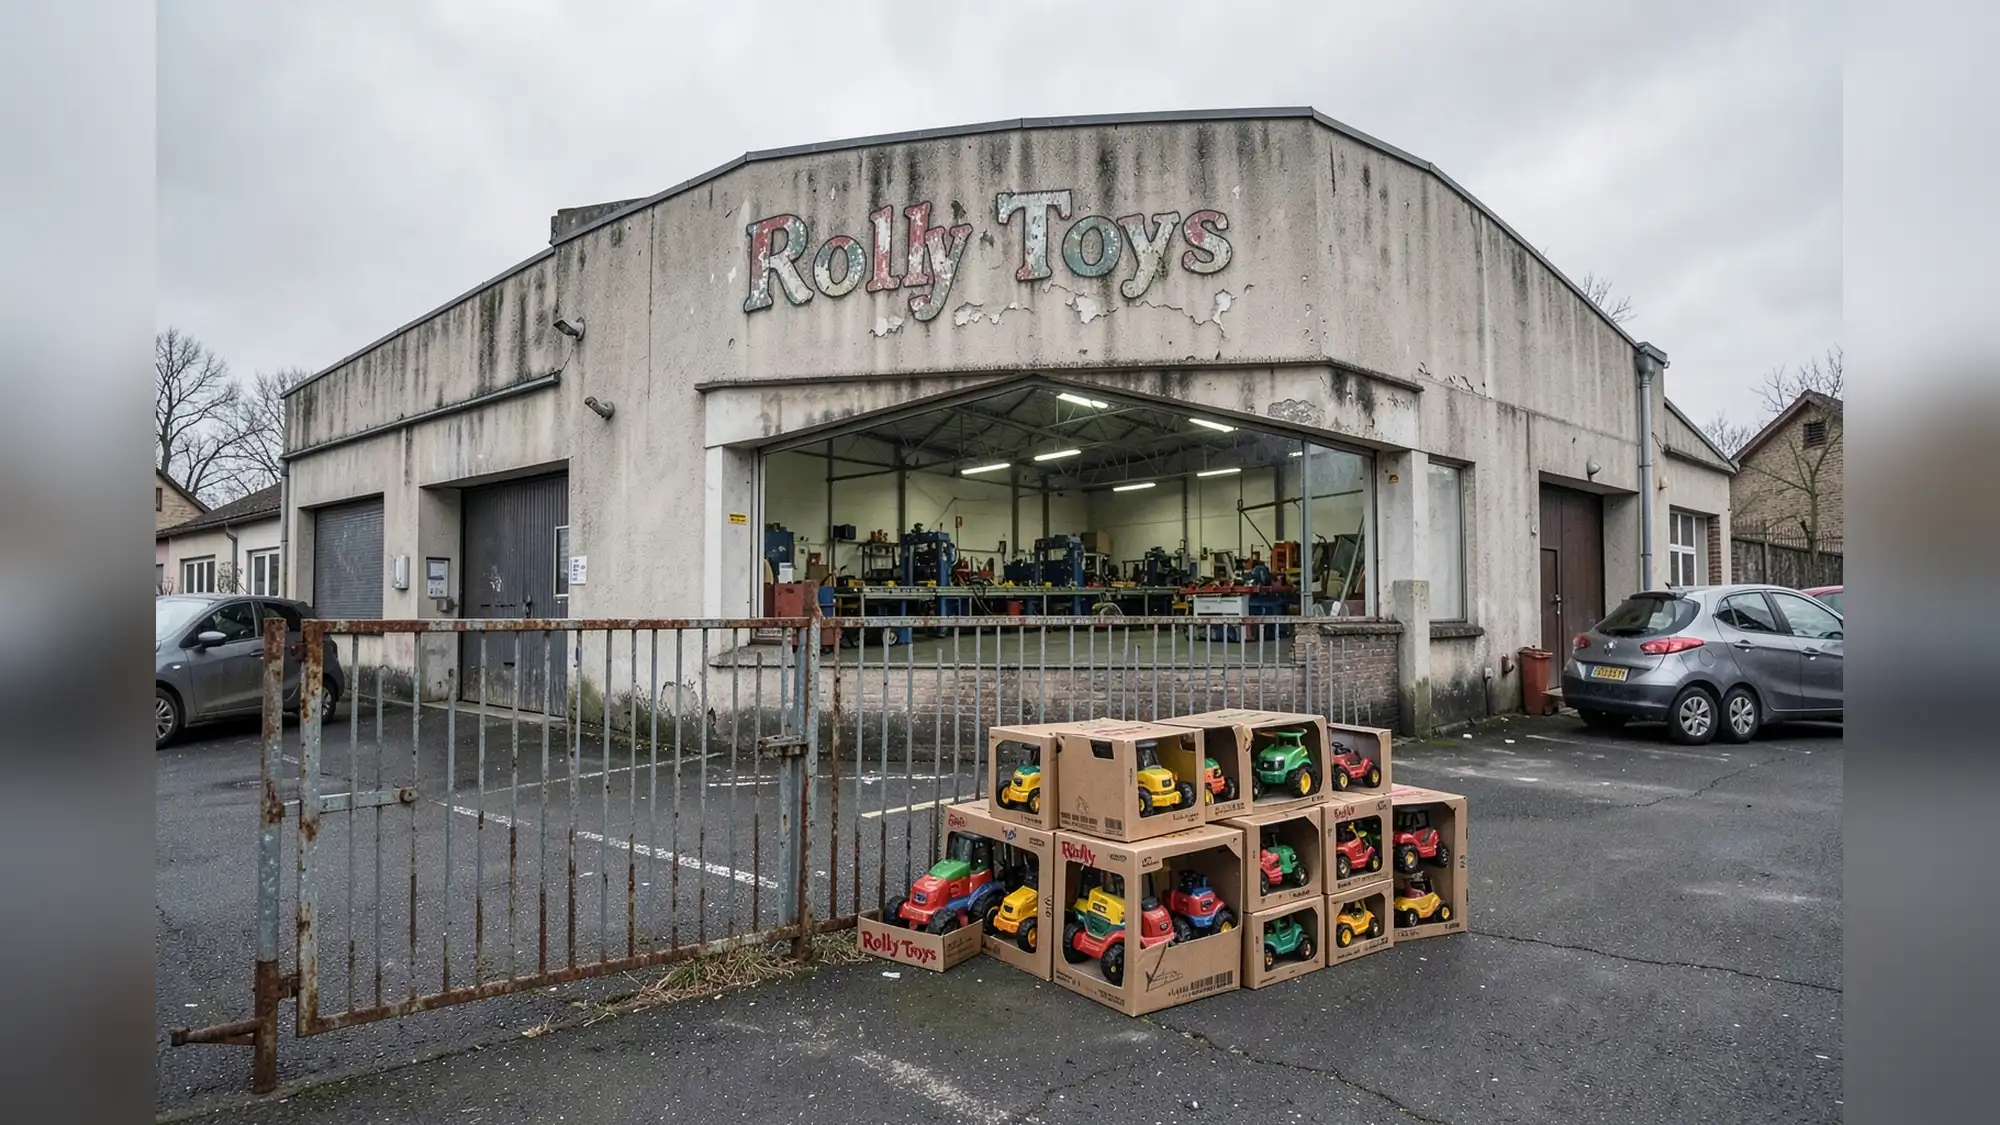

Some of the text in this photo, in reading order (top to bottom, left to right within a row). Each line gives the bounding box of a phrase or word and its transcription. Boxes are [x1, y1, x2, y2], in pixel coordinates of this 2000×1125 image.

[744, 188, 1234, 322] Rolly Toys
[861, 930, 899, 957] Rolly
